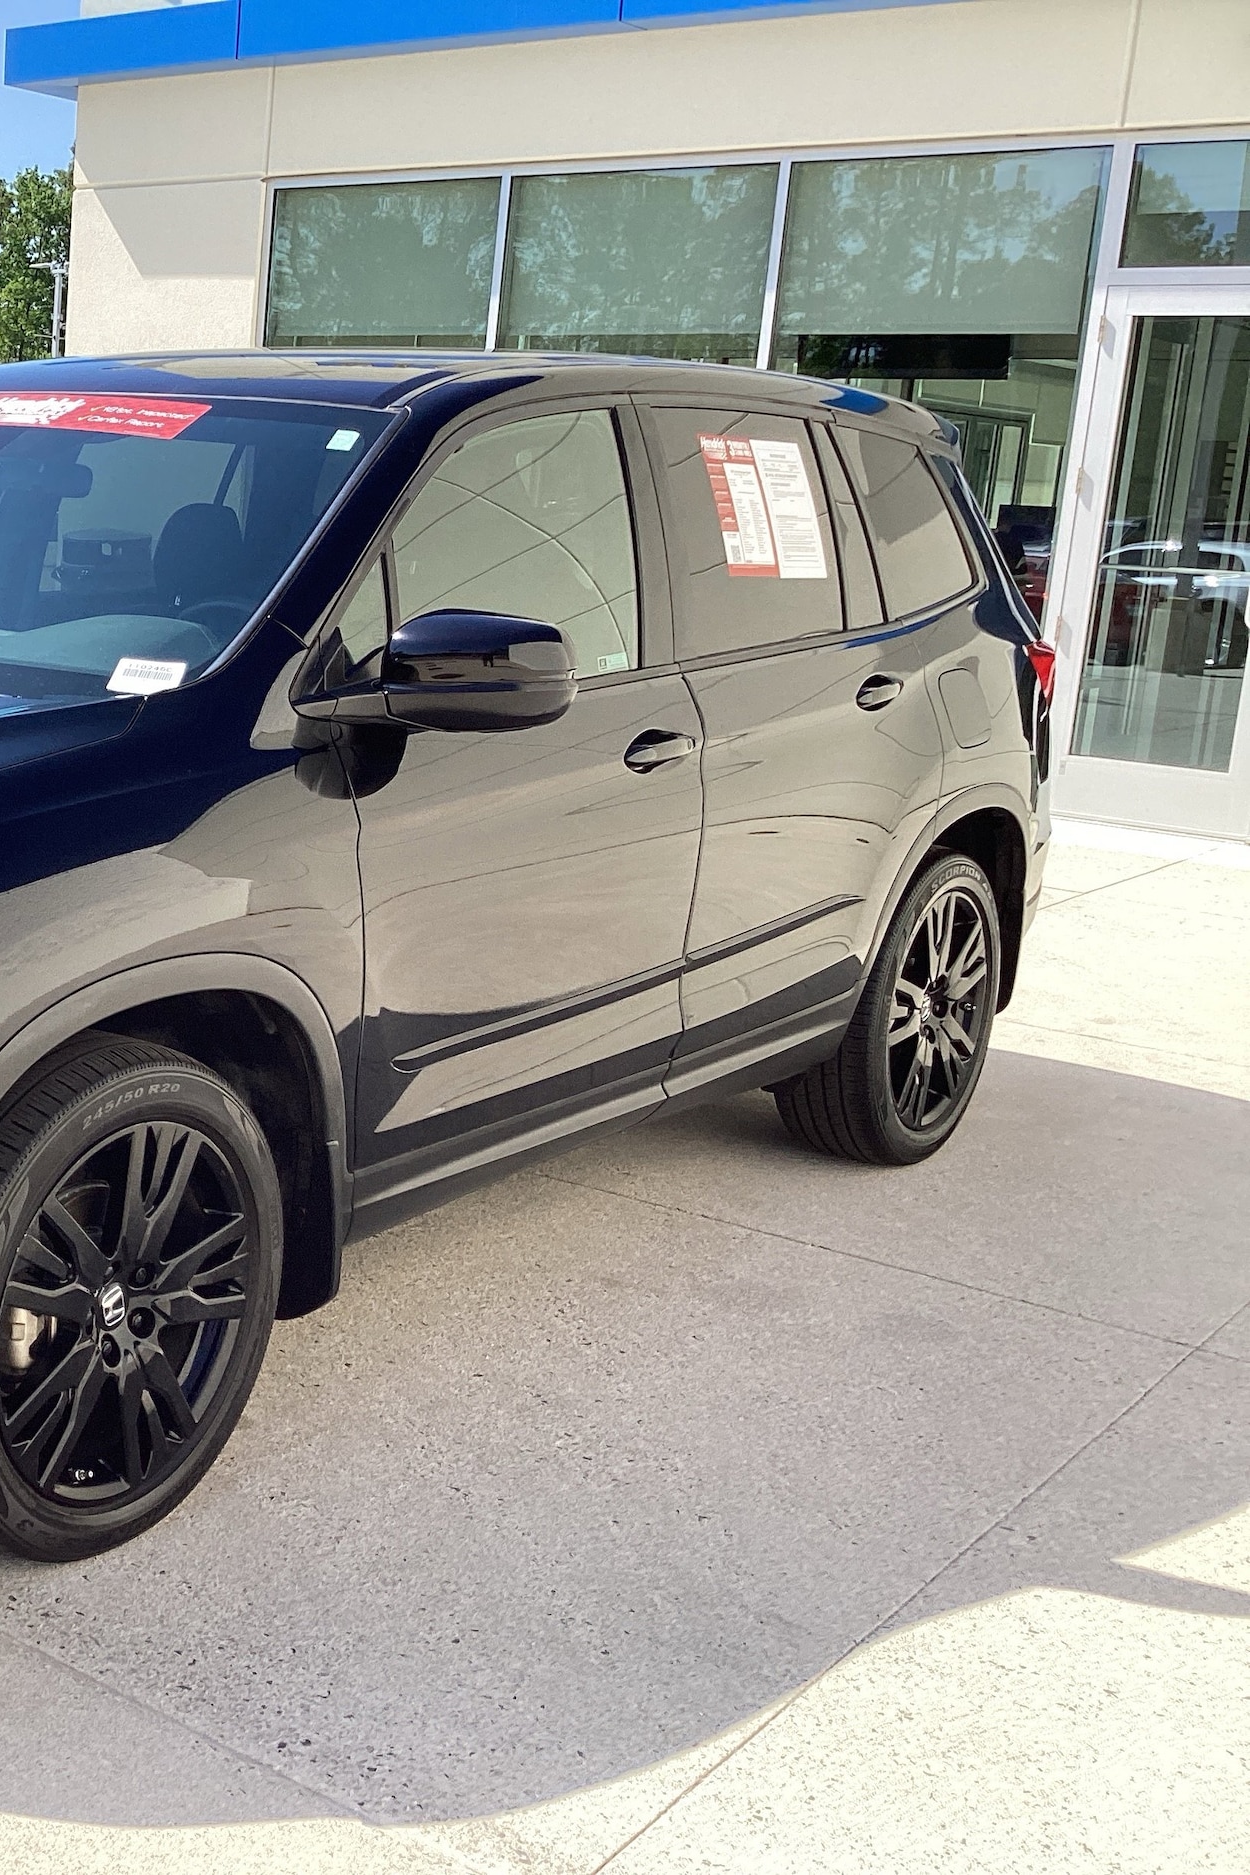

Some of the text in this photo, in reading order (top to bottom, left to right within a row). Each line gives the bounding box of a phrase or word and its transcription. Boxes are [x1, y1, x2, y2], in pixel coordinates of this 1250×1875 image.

[931, 864, 982, 895] SCORPION
[82, 1083, 181, 1131] 245/50 R20
